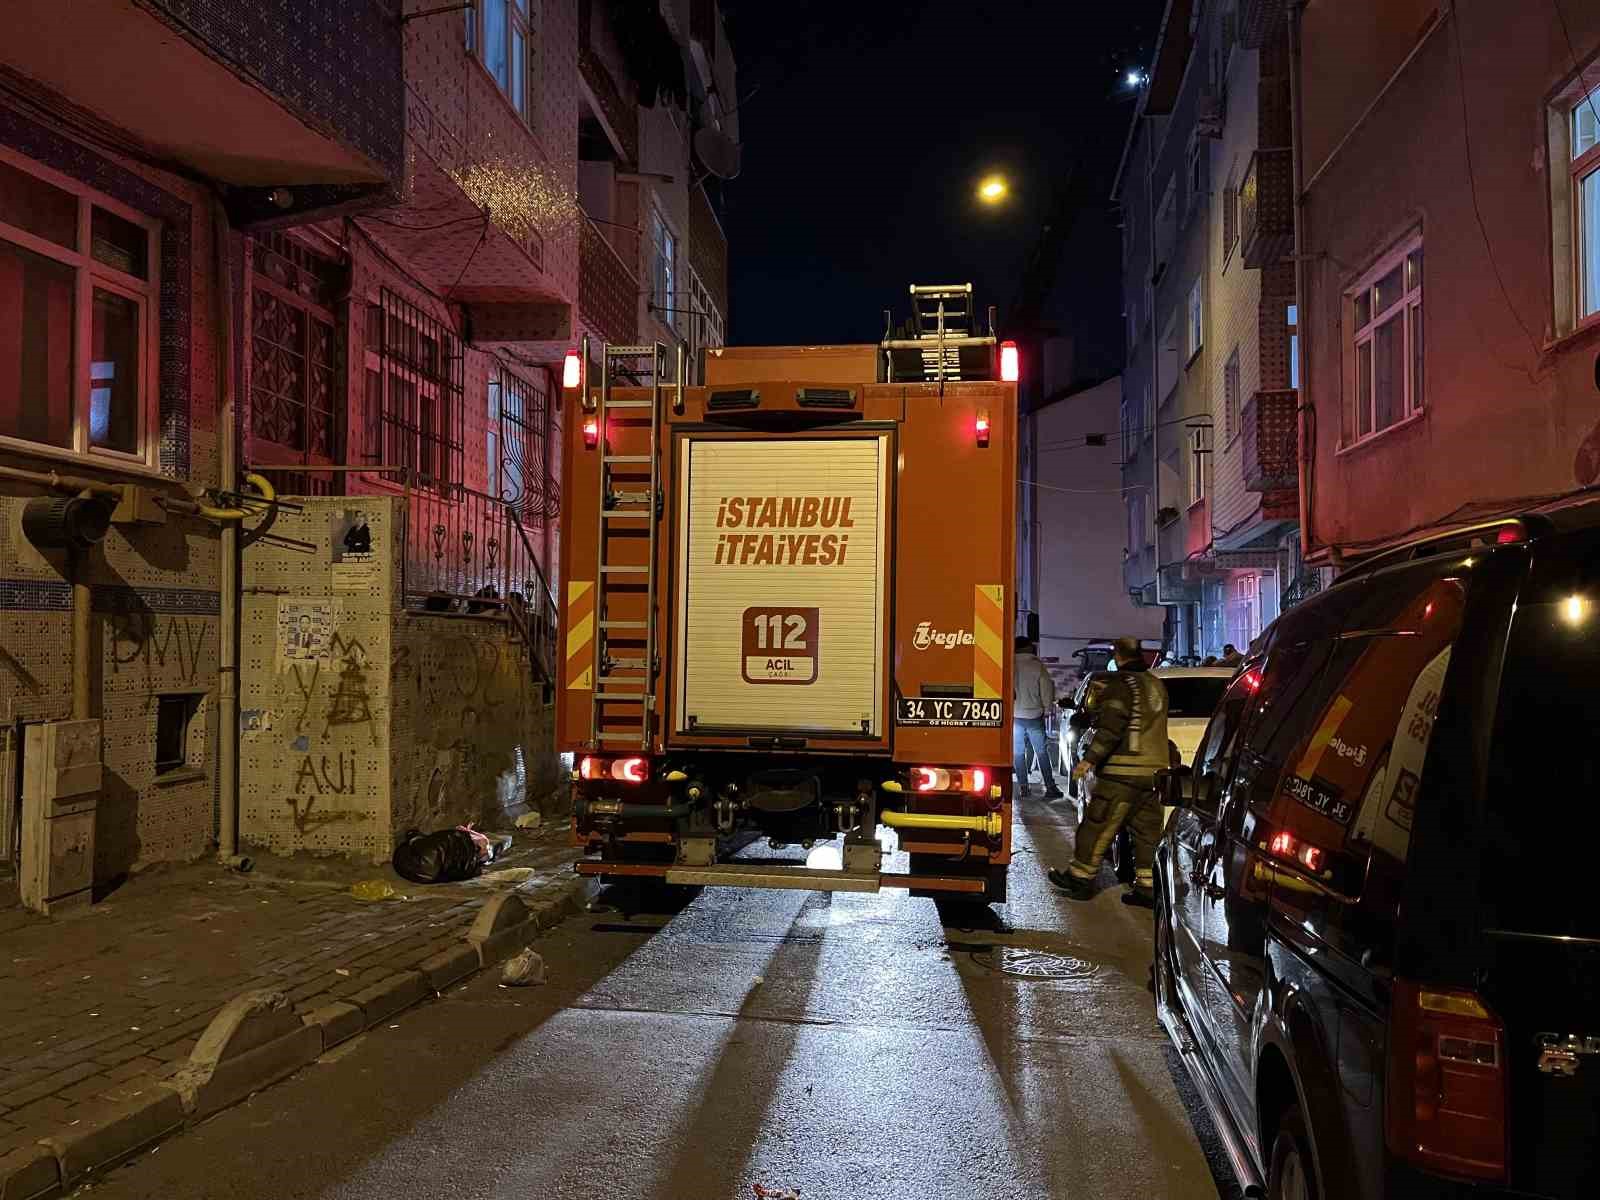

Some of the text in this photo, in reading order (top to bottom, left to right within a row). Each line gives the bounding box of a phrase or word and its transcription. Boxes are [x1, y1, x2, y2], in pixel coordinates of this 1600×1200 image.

[754, 614, 807, 649] 112
[906, 700, 1000, 720] 34 YC 7840
